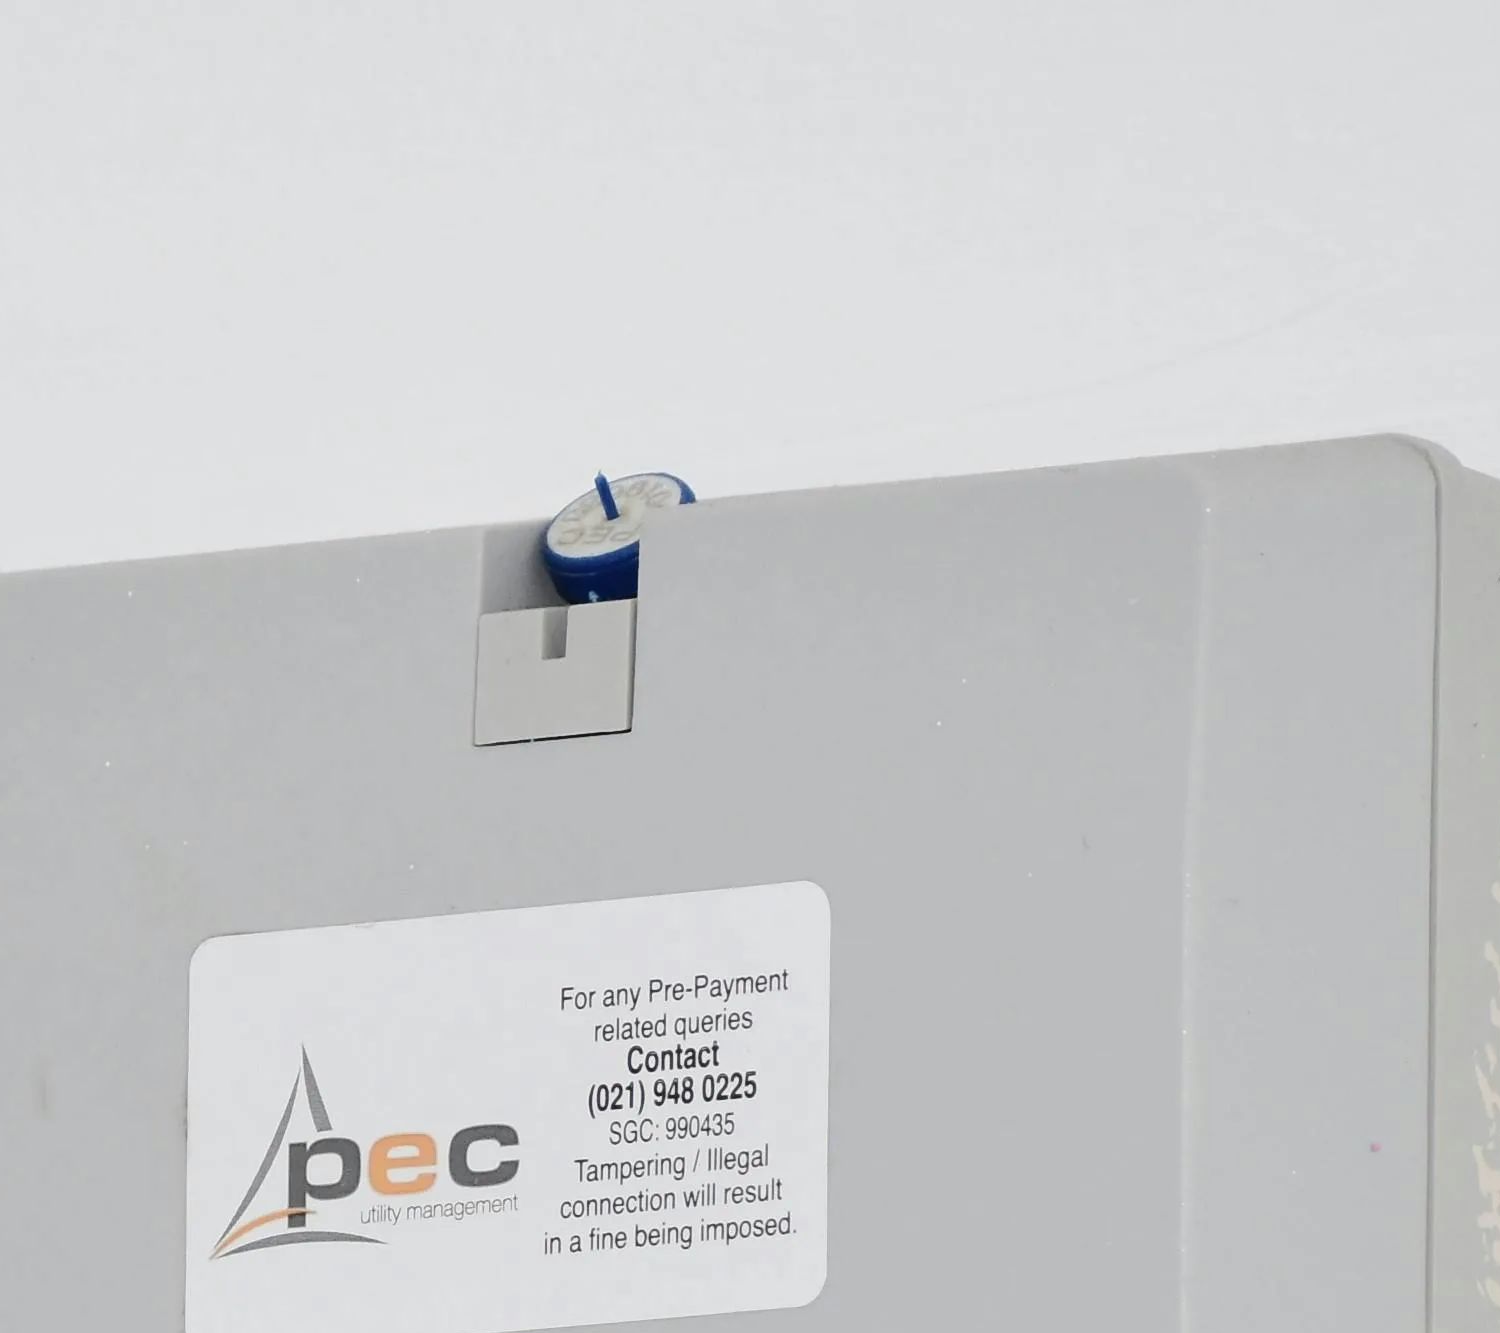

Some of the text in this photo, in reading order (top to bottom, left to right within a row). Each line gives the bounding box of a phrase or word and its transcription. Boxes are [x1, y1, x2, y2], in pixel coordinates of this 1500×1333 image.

[560, 968, 789, 1011] For any Pre-Payment
[594, 1007, 754, 1042] related queries
[627, 1040, 720, 1074] Contact
[588, 1070, 758, 1119] (021) 948 0225
[609, 1112, 736, 1145] SGC: 990435
[287, 1123, 521, 1229] pec
[574, 1143, 769, 1185] Tampering / Illegal
[360, 1194, 520, 1231] utility management
[560, 1177, 783, 1219] connection will result
[544, 1211, 798, 1255] in a fine being imposed.
